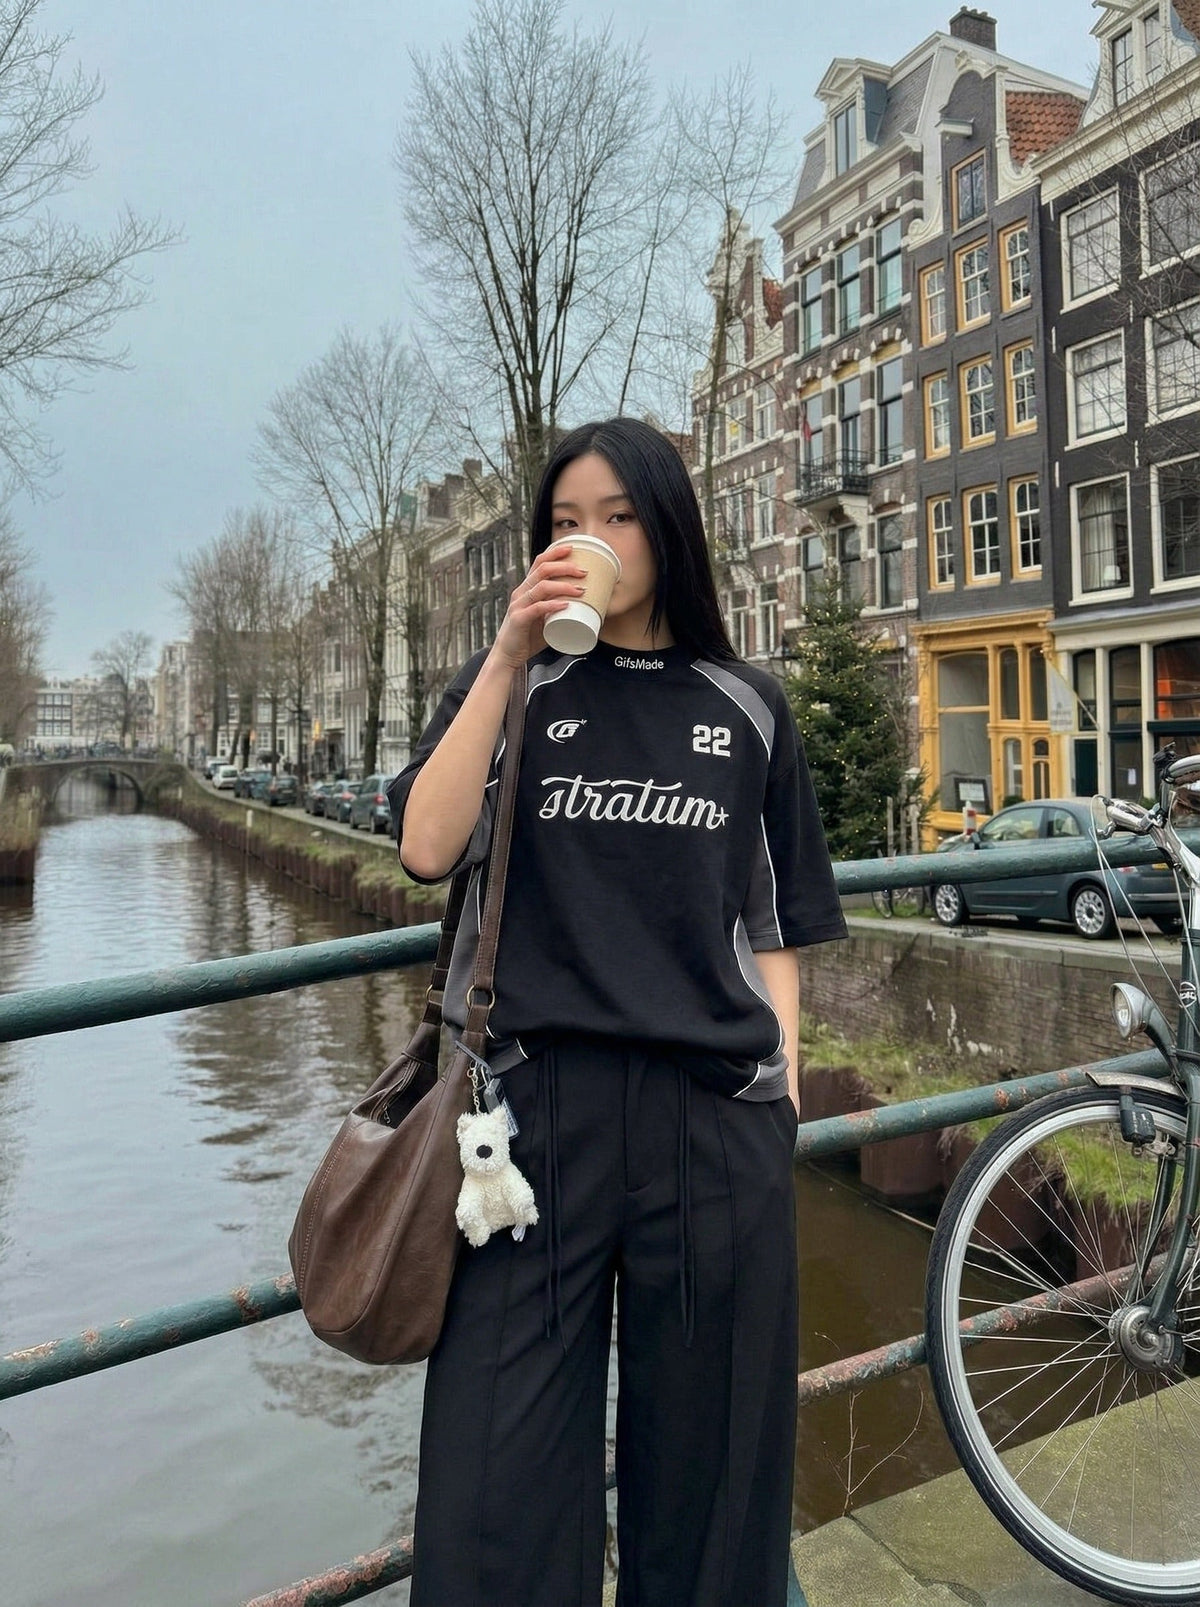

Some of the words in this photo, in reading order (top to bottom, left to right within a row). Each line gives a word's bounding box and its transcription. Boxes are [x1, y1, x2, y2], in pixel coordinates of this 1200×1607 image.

[614, 656, 664, 670] GifsMade
[692, 724, 731, 757] 22
[538, 774, 721, 830] stratum
